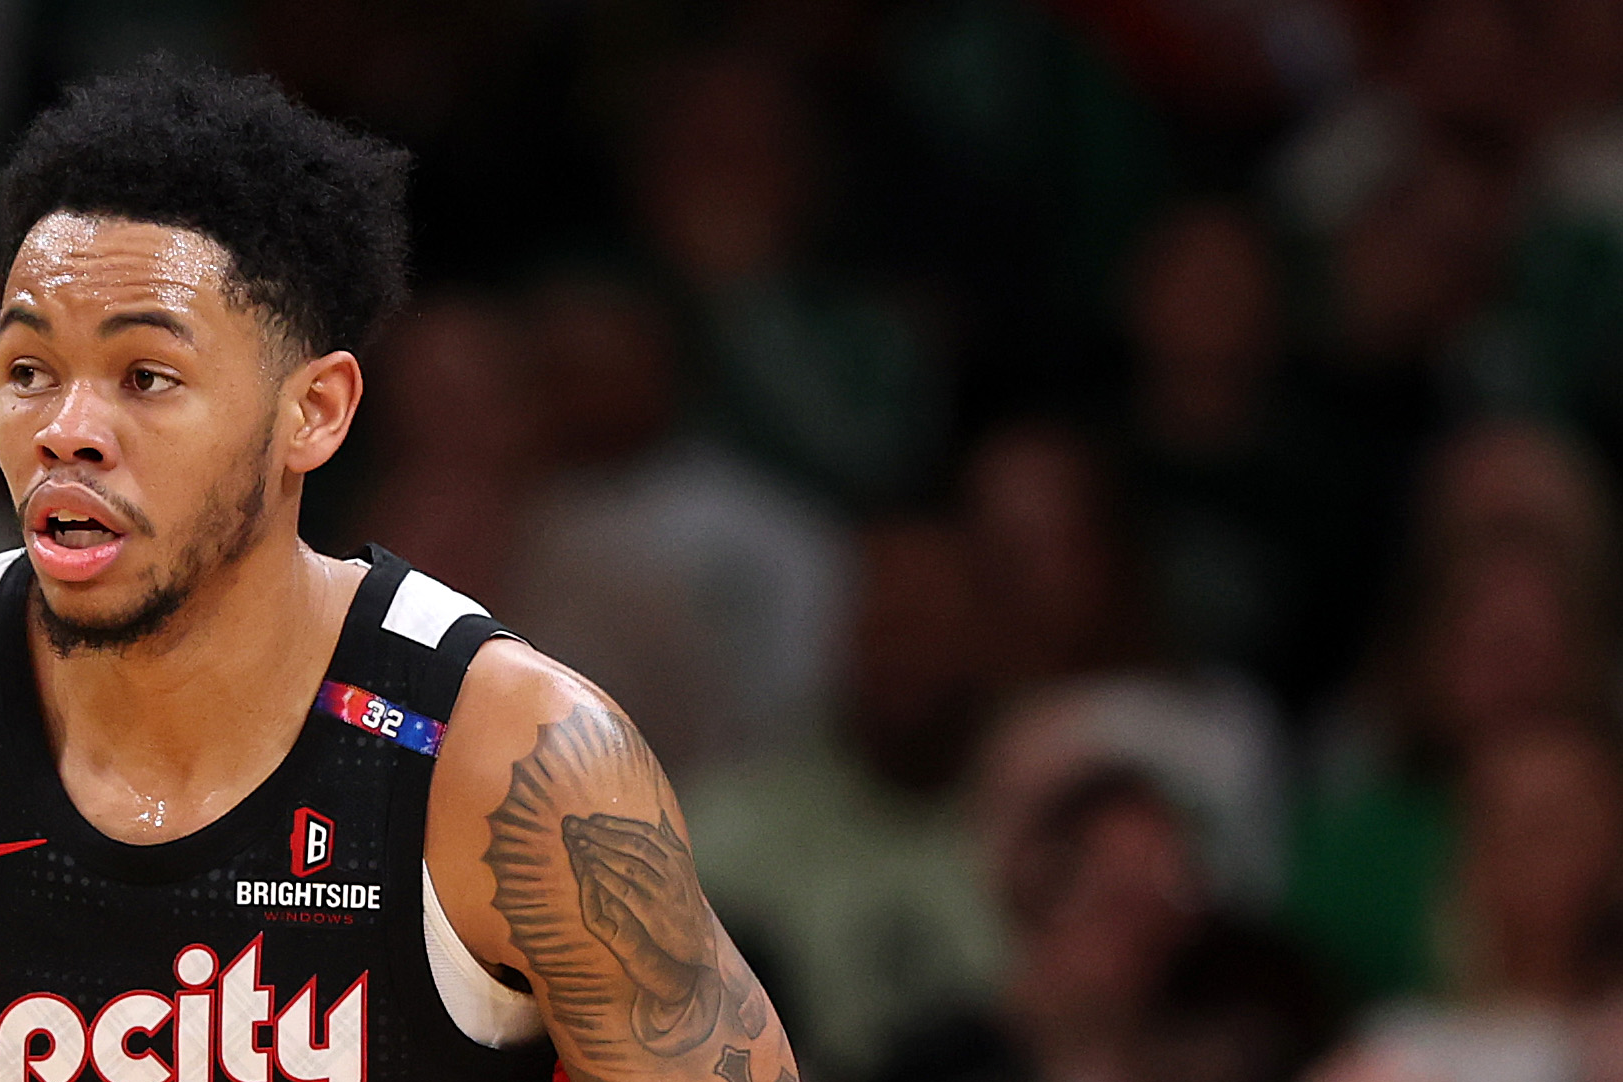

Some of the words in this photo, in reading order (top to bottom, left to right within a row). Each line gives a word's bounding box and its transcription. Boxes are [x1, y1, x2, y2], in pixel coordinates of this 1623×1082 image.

[360, 699, 405, 739] 32
[307, 820, 328, 865] B
[236, 880, 381, 910] BRIGHTSIDE
[263, 910, 354, 925] WINDOWS
